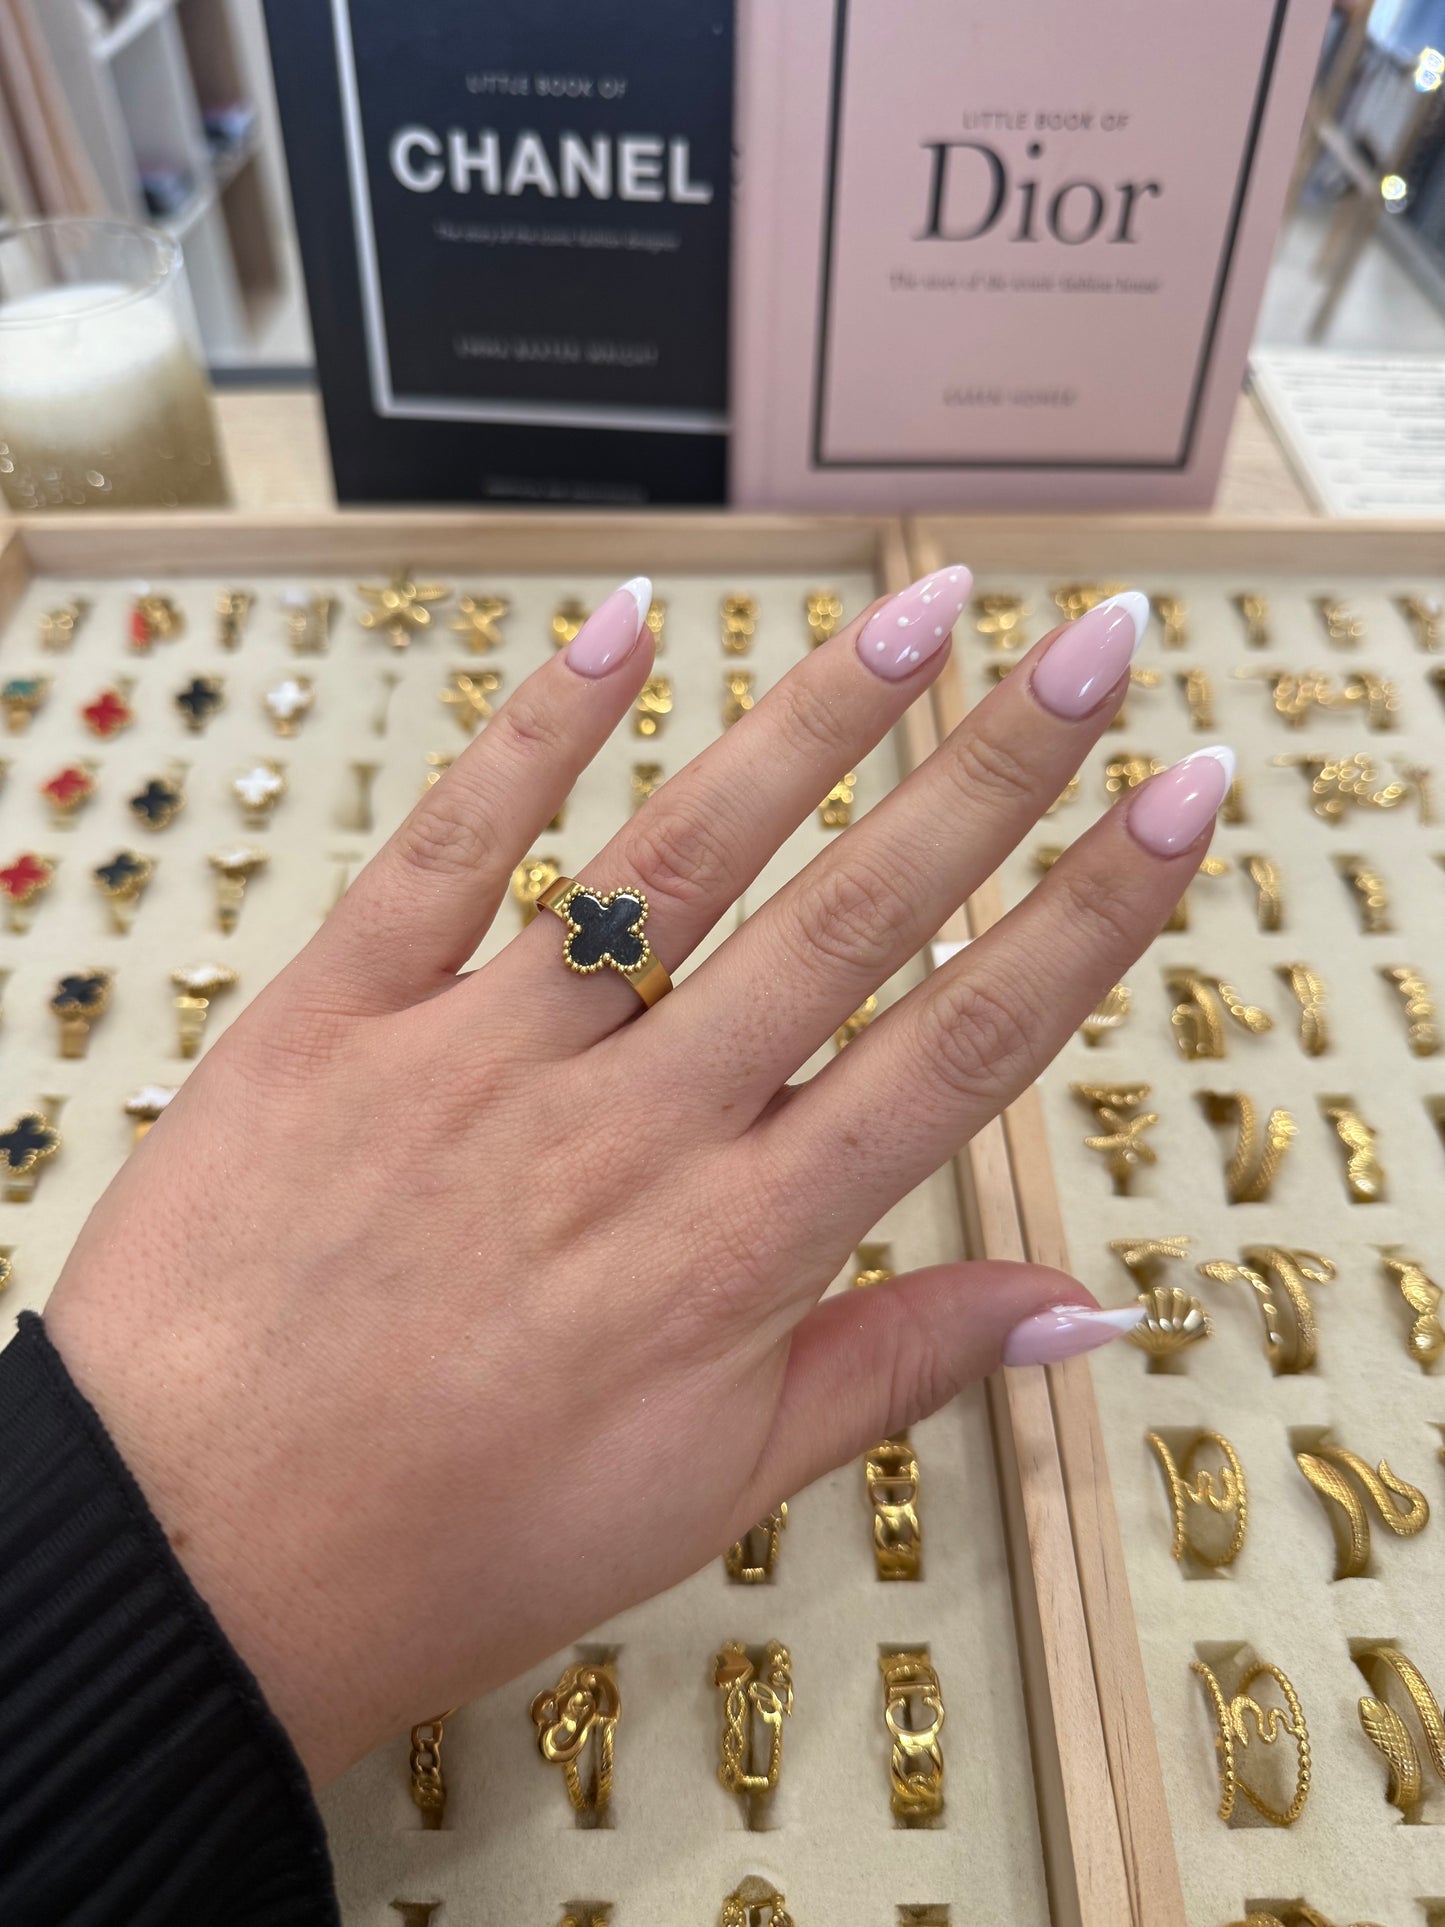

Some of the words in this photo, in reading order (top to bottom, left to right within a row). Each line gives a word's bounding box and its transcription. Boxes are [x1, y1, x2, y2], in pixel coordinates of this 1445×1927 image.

[533, 74, 594, 98] BOOK
[962, 110, 1028, 130] LITTLE
[1034, 111, 1094, 131] BOOK
[1100, 112, 1130, 132] OF
[390, 124, 714, 205] CHANEL
[911, 138, 1162, 246] Dior
